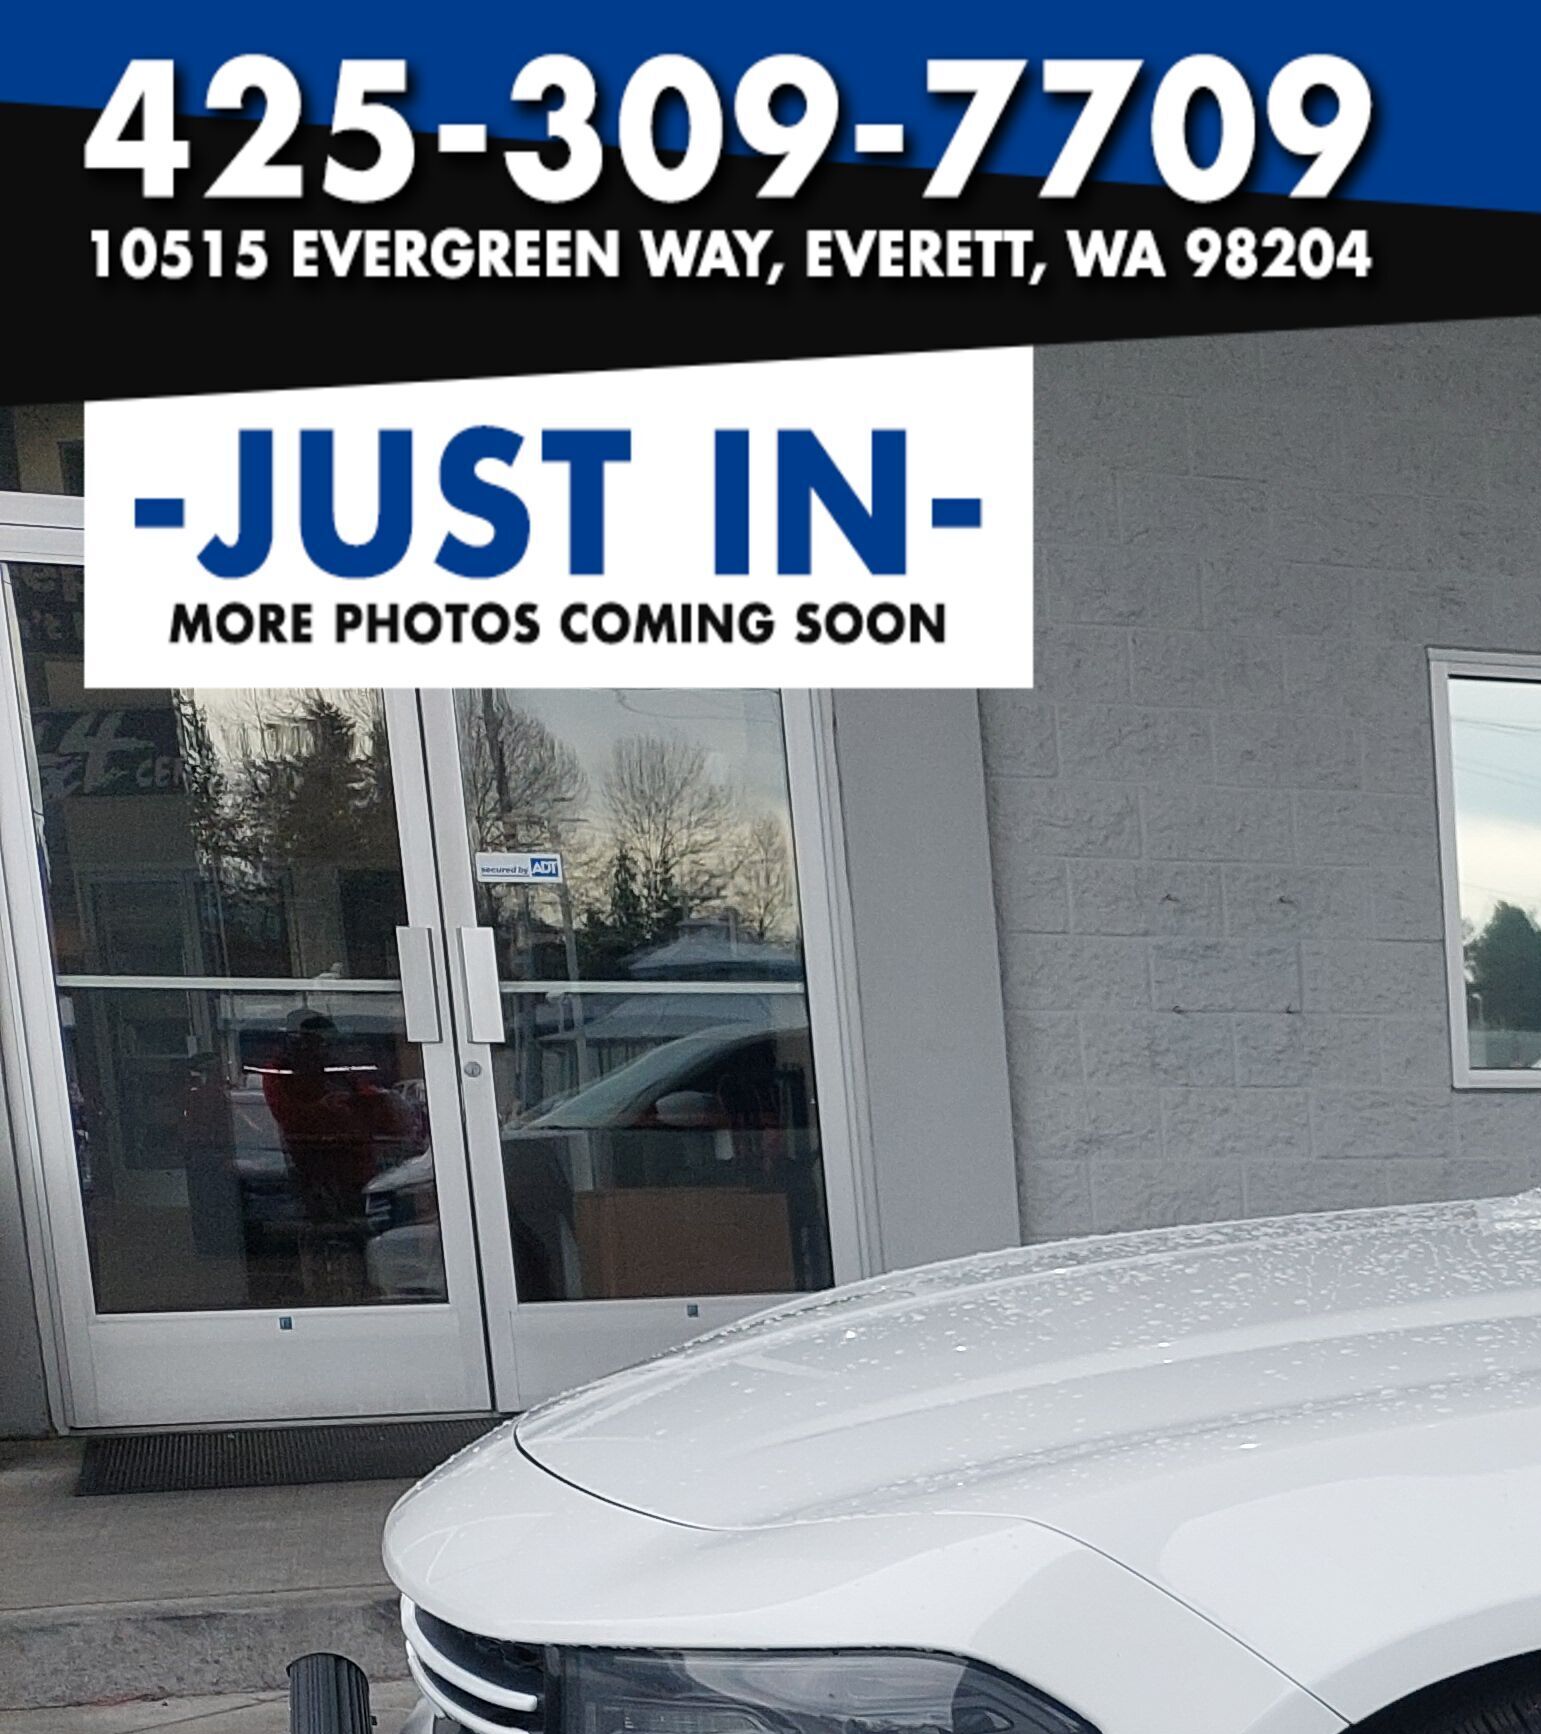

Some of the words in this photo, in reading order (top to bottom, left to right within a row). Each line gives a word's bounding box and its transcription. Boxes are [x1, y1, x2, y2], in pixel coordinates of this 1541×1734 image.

[481, 866, 517, 874] secured
[518, 866, 529, 875] by
[532, 861, 558, 874] ADT
